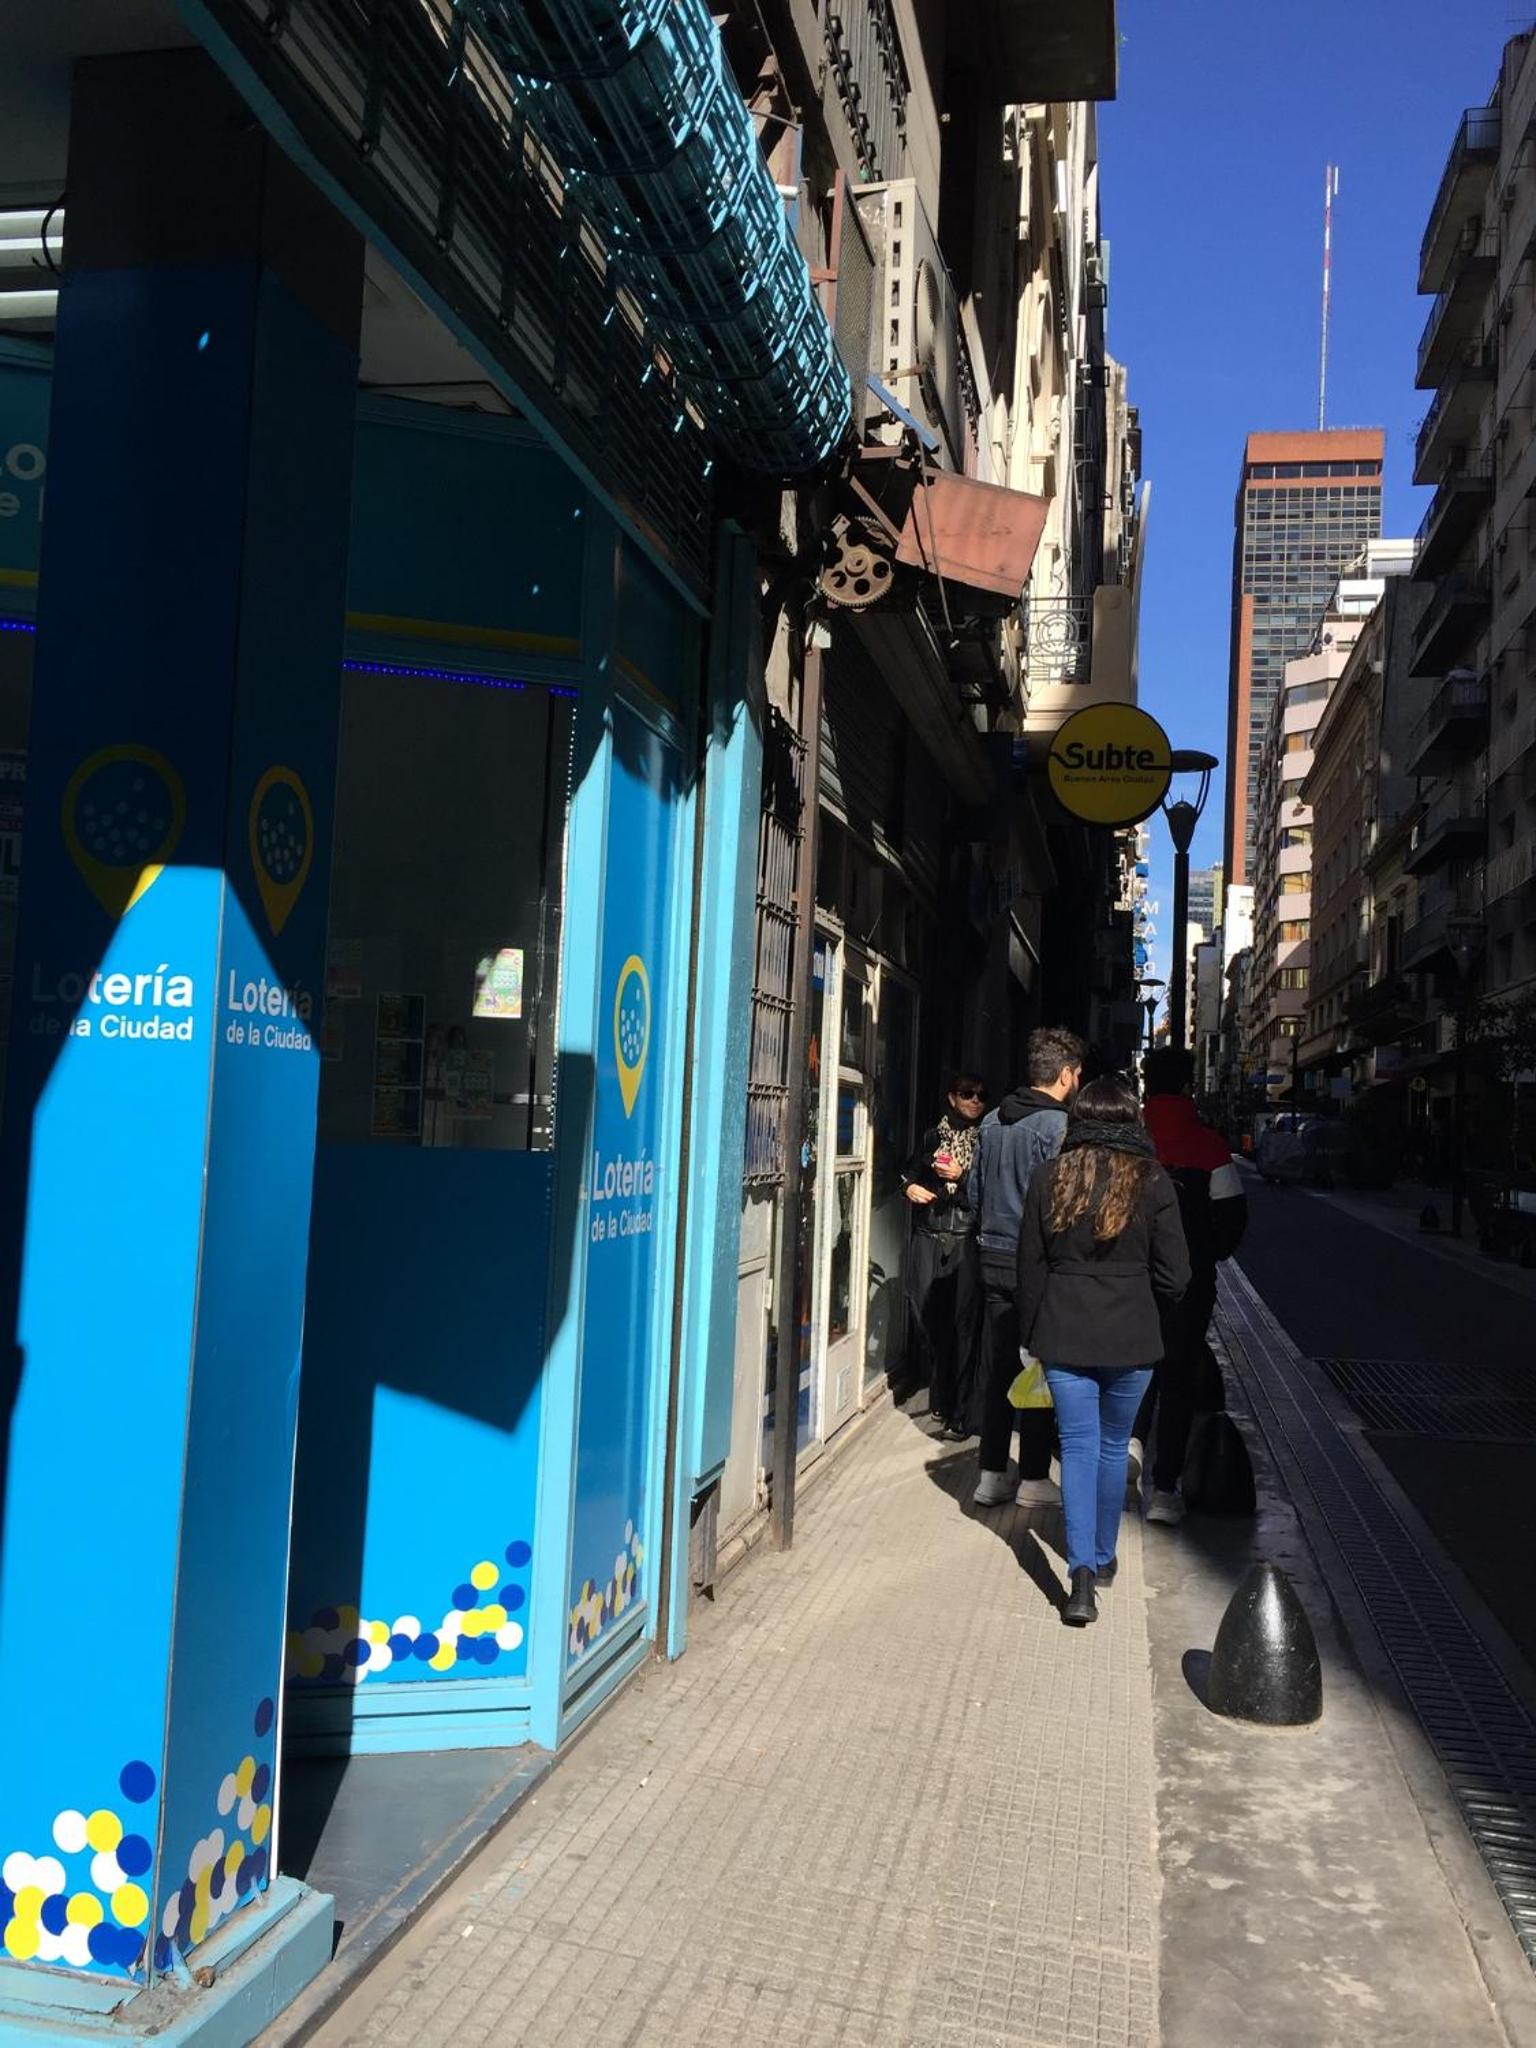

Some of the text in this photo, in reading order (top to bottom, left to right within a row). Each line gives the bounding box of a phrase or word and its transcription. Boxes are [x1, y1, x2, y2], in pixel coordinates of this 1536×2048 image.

[1065, 742, 1155, 771] Subte
[1063, 774, 1097, 784] Buenos
[1098, 774, 1121, 784] Aires
[31, 961, 194, 1008] Lotería
[228, 968, 313, 1021] Lotería
[28, 1011, 194, 1041] de la Ciudad
[226, 1019, 312, 1051] de la Ciudad
[592, 1147, 654, 1201] Lotería
[591, 1205, 653, 1242] de la Ciudad
